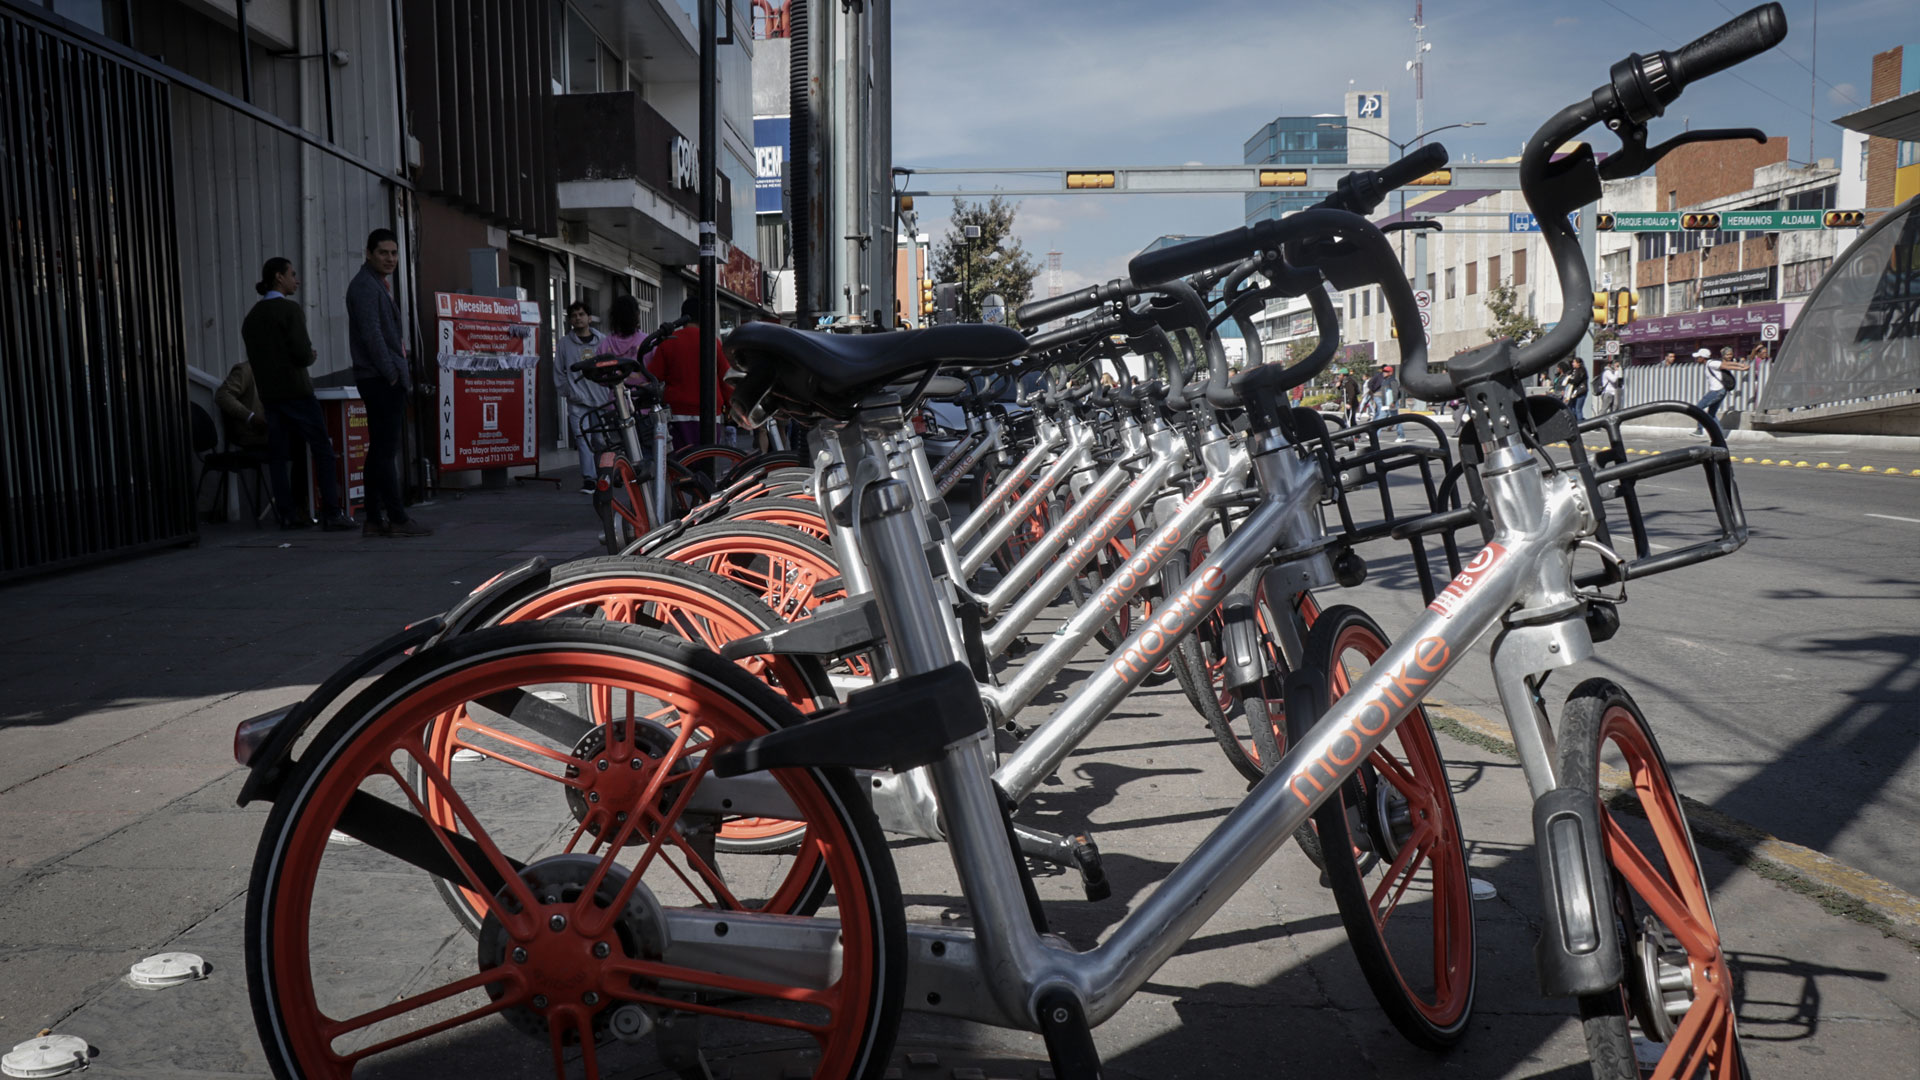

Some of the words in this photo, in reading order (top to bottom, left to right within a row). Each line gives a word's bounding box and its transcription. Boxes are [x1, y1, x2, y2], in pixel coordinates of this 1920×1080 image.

[1617, 216, 1642, 226] PARQUE
[1642, 217, 1669, 226] HIDALGO
[1727, 214, 1772, 226] HERMANOS
[1781, 214, 1816, 226] ALDAMA
[454, 298, 493, 314] ¿Necesitas
[494, 302, 518, 316] Dinero?
[466, 456, 484, 464] Marca
[491, 454, 500, 462] 713
[472, 447, 489, 455] Mayor
[490, 444, 520, 453] Información
[938, 455, 974, 493] mobike
[1064, 500, 1132, 570] mobike
[1099, 526, 1181, 612] mobike
[1112, 566, 1227, 684] mobike
[1288, 636, 1450, 807] mobike
